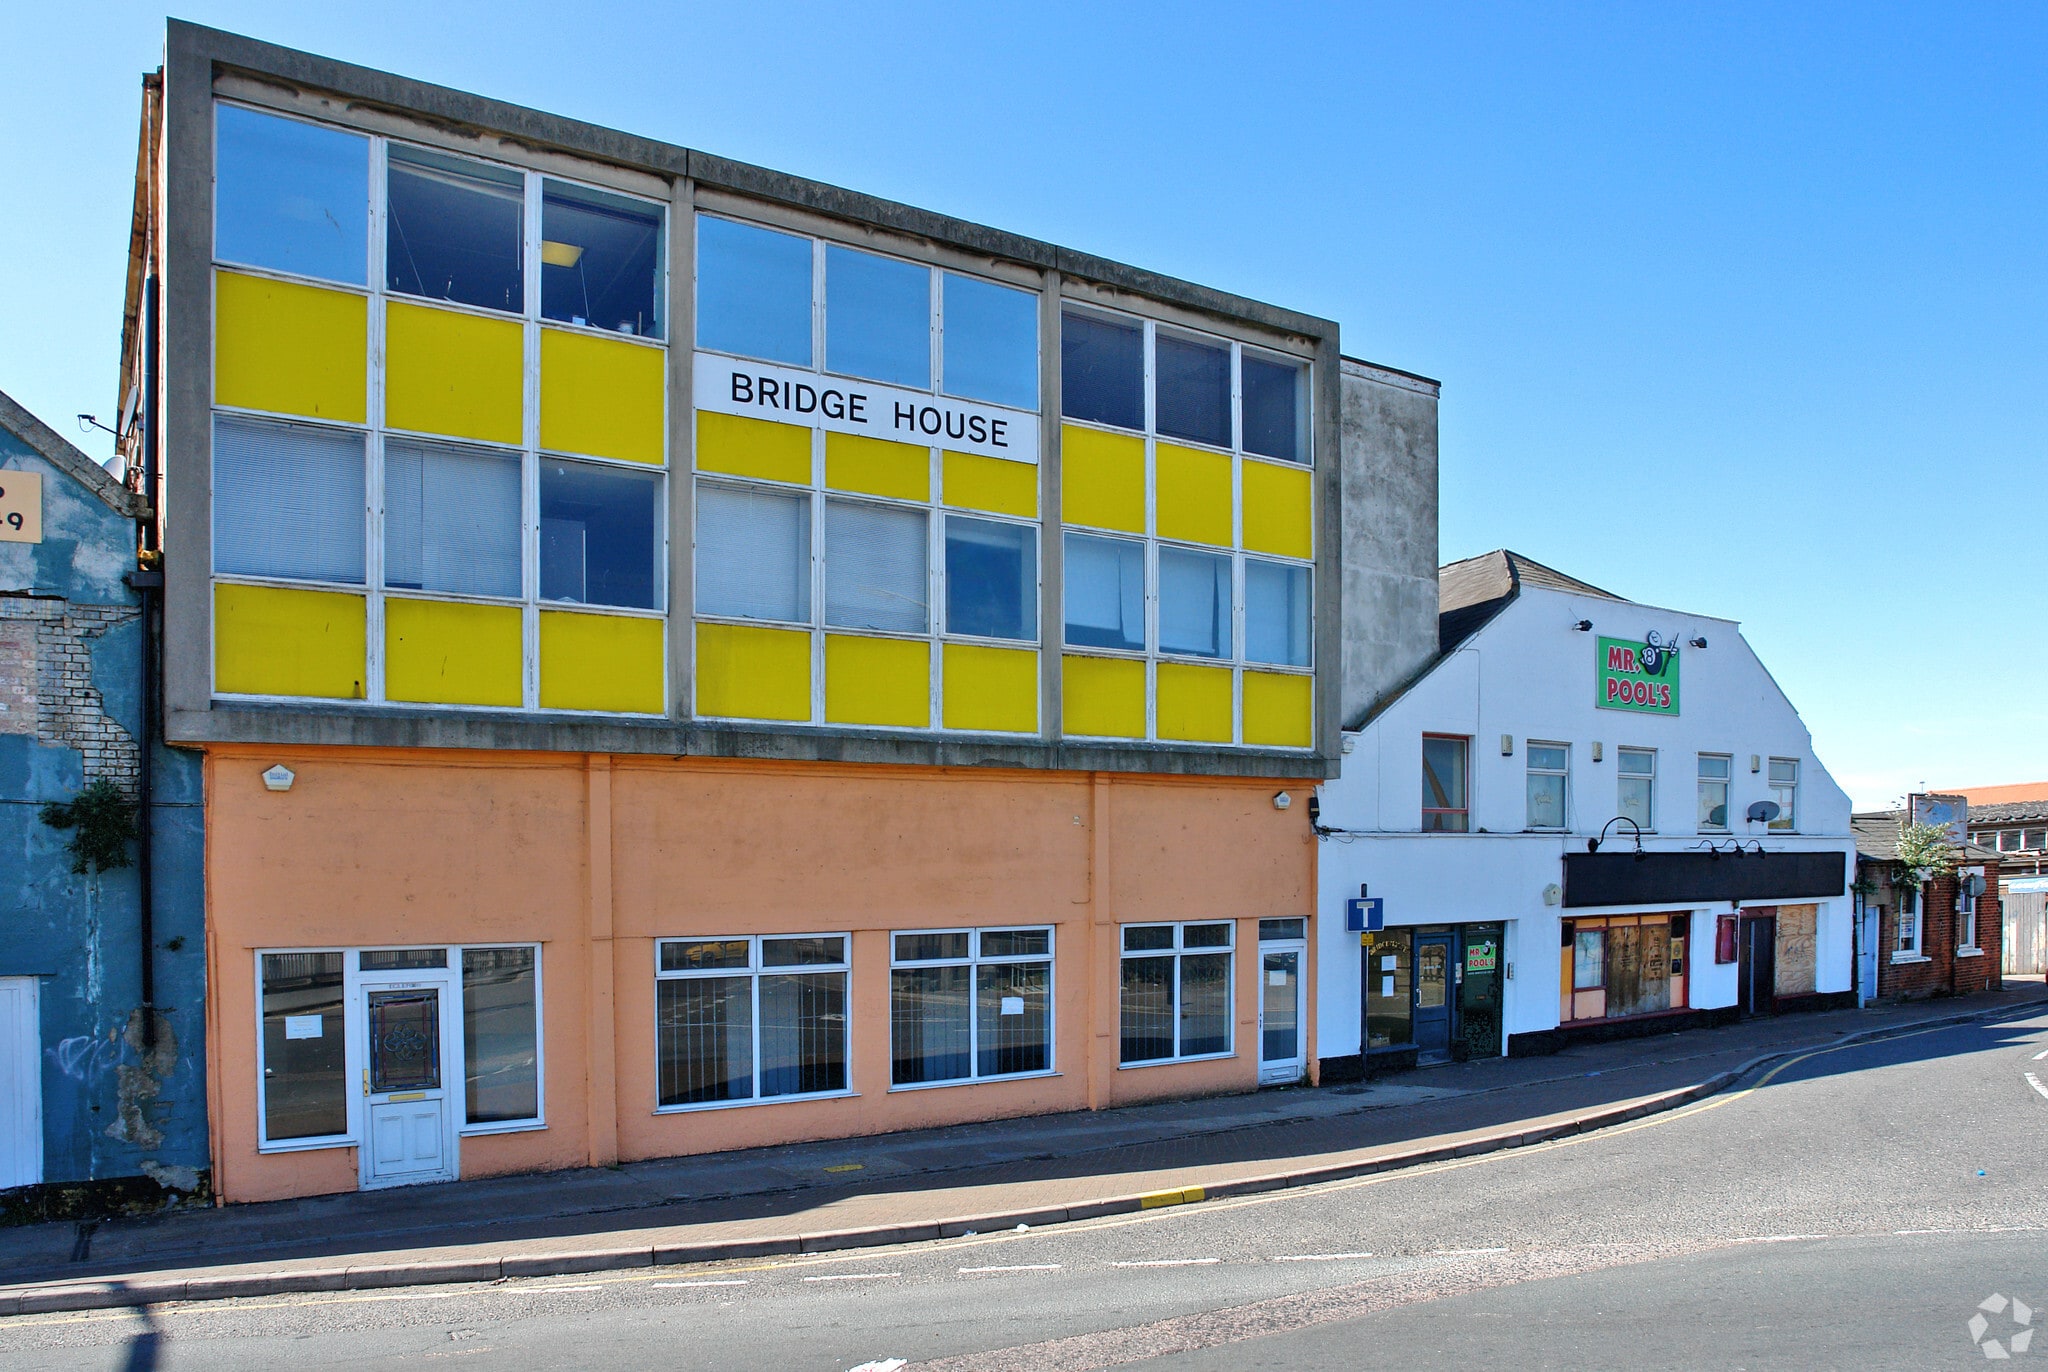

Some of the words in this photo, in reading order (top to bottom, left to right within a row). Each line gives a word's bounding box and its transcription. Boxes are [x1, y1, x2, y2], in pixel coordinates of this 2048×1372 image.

[731, 372, 868, 423] BRIDGE
[894, 401, 1008, 448] HOUSE
[0, 511, 24, 531] 9
[1607, 645, 1641, 673] MR.
[1607, 678, 1671, 707] POOL'S
[1468, 957, 1495, 968] POOL'S
